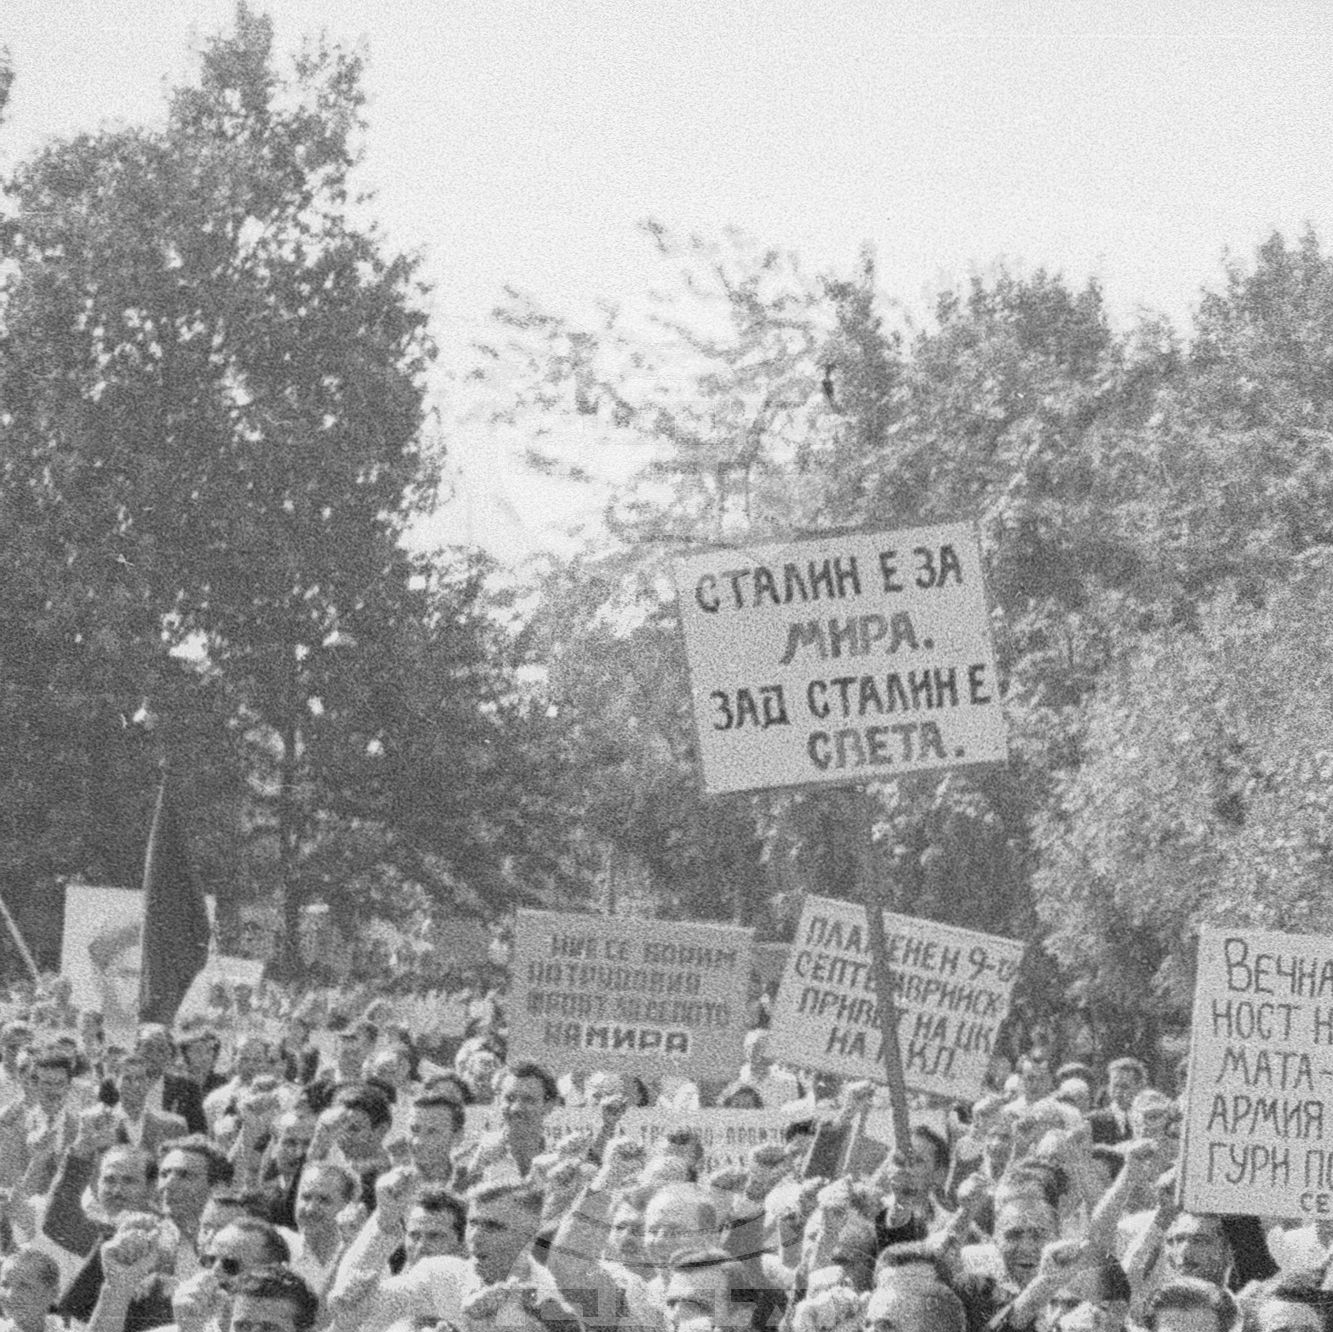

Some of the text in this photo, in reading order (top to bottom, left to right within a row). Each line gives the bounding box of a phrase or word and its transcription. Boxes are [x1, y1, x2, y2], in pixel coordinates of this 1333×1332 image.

[695, 544, 963, 614] СТАЛИН Е ЗА
[778, 610, 936, 666] МИРА.
[709, 662, 992, 732] ЗАД СТАЛИН Е
[585, 1025, 690, 1054] МИРА
[826, 1027, 868, 1056] НА
[1211, 999, 1302, 1041] НОСТ
[1206, 1093, 1325, 1140] АРМИЯ
